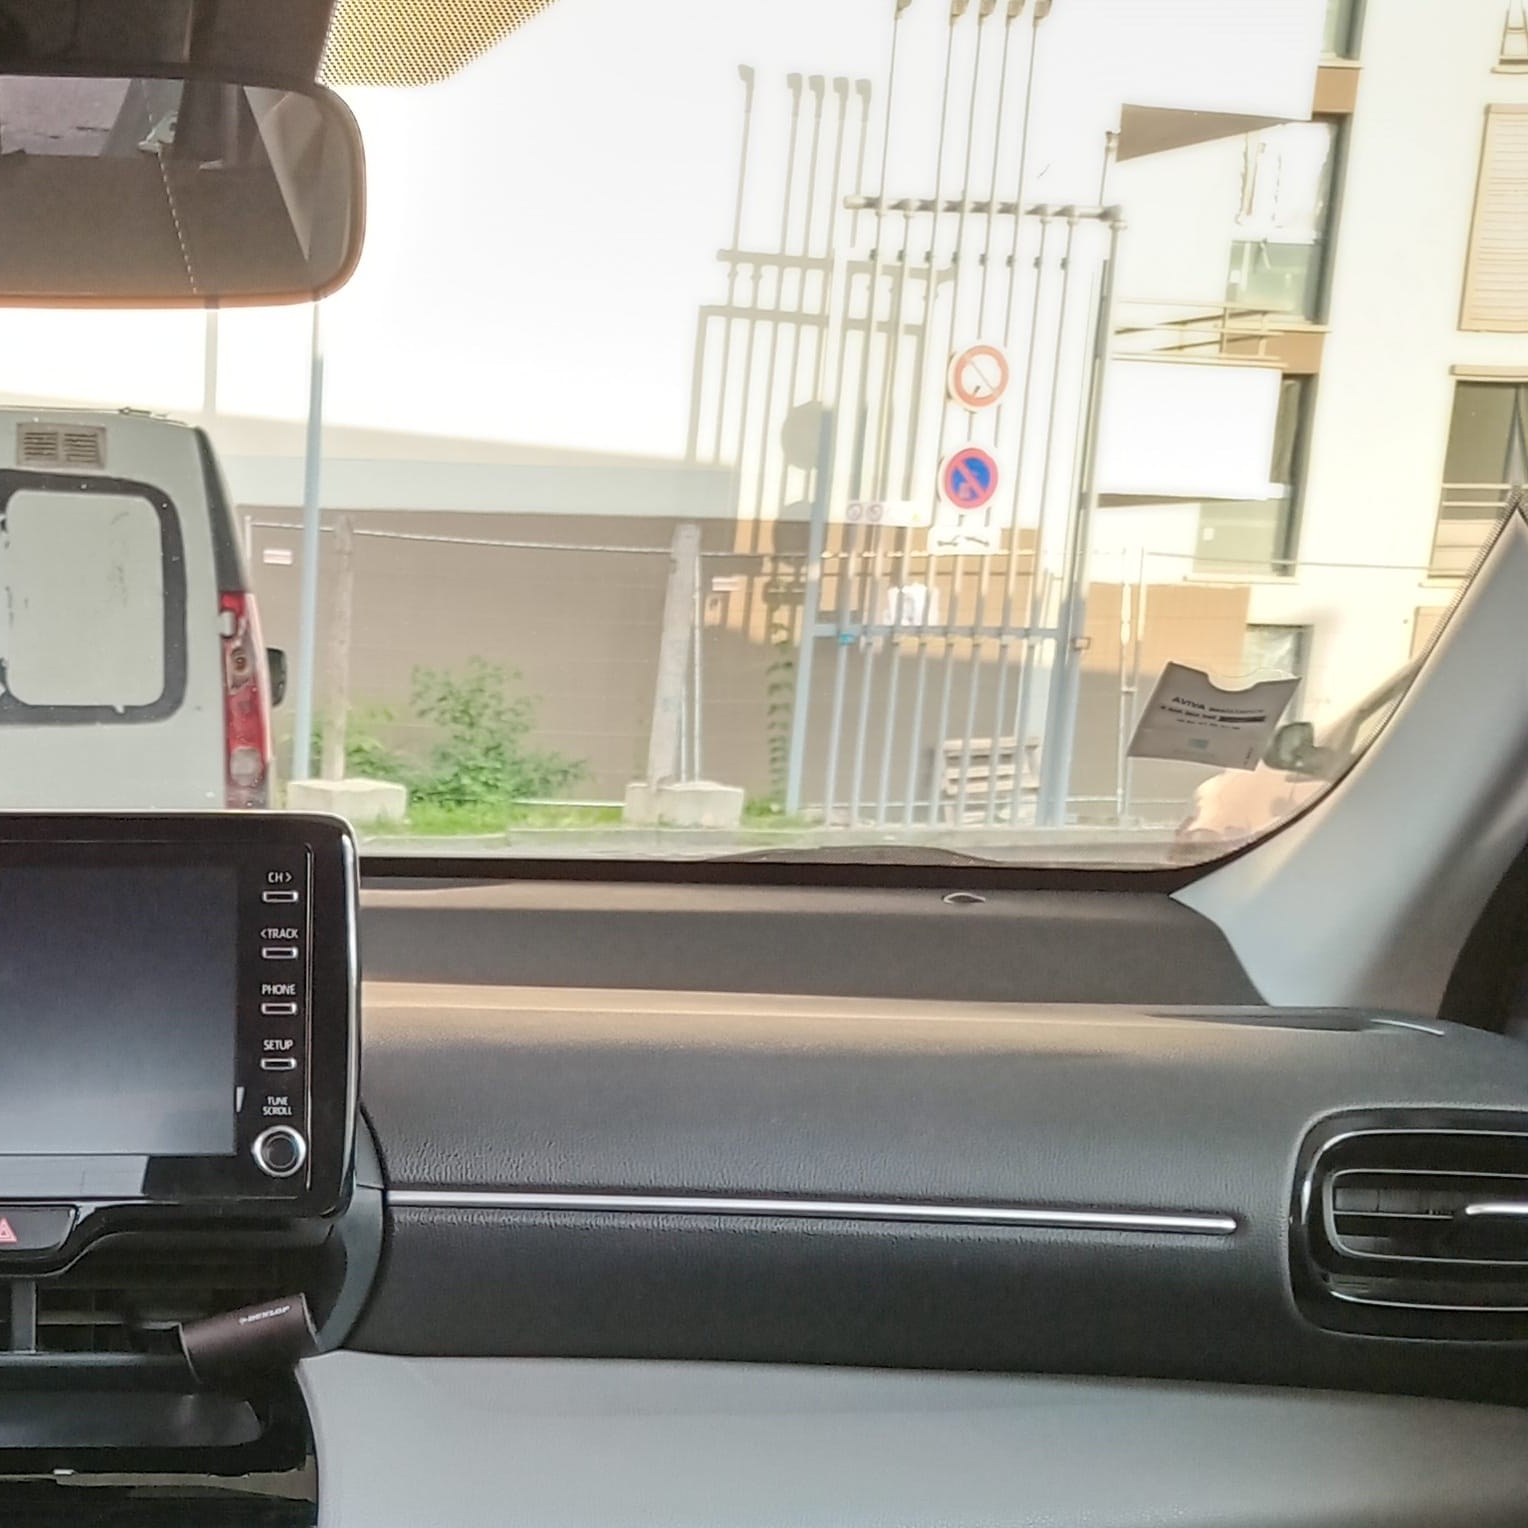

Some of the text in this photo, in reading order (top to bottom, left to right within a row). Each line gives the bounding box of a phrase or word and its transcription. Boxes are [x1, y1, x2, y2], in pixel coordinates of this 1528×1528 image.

[261, 984, 296, 995] PHONE
[263, 1040, 294, 1051] SETUP
[267, 1096, 288, 1106] TUNE
[262, 1106, 292, 1116] SCROLL
